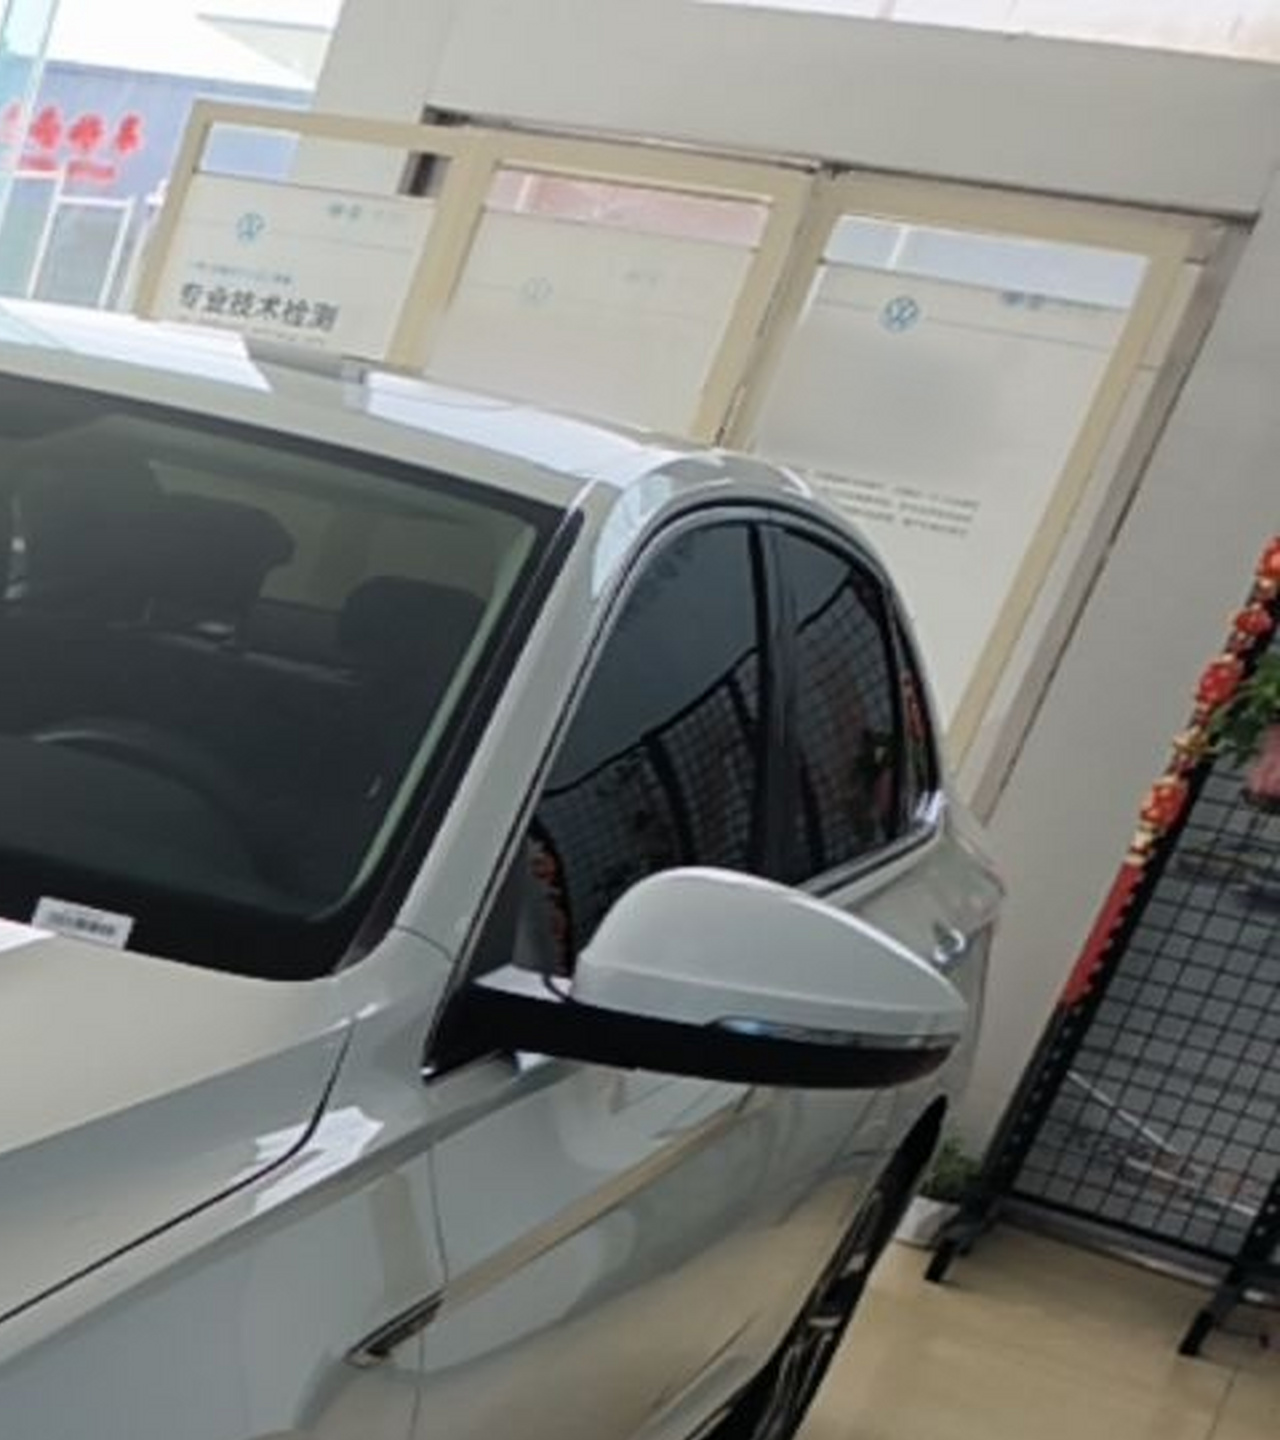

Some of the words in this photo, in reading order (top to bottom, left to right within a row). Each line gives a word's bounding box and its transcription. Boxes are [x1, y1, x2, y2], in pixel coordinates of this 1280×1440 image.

[180, 281, 340, 333] 专业技术检测
